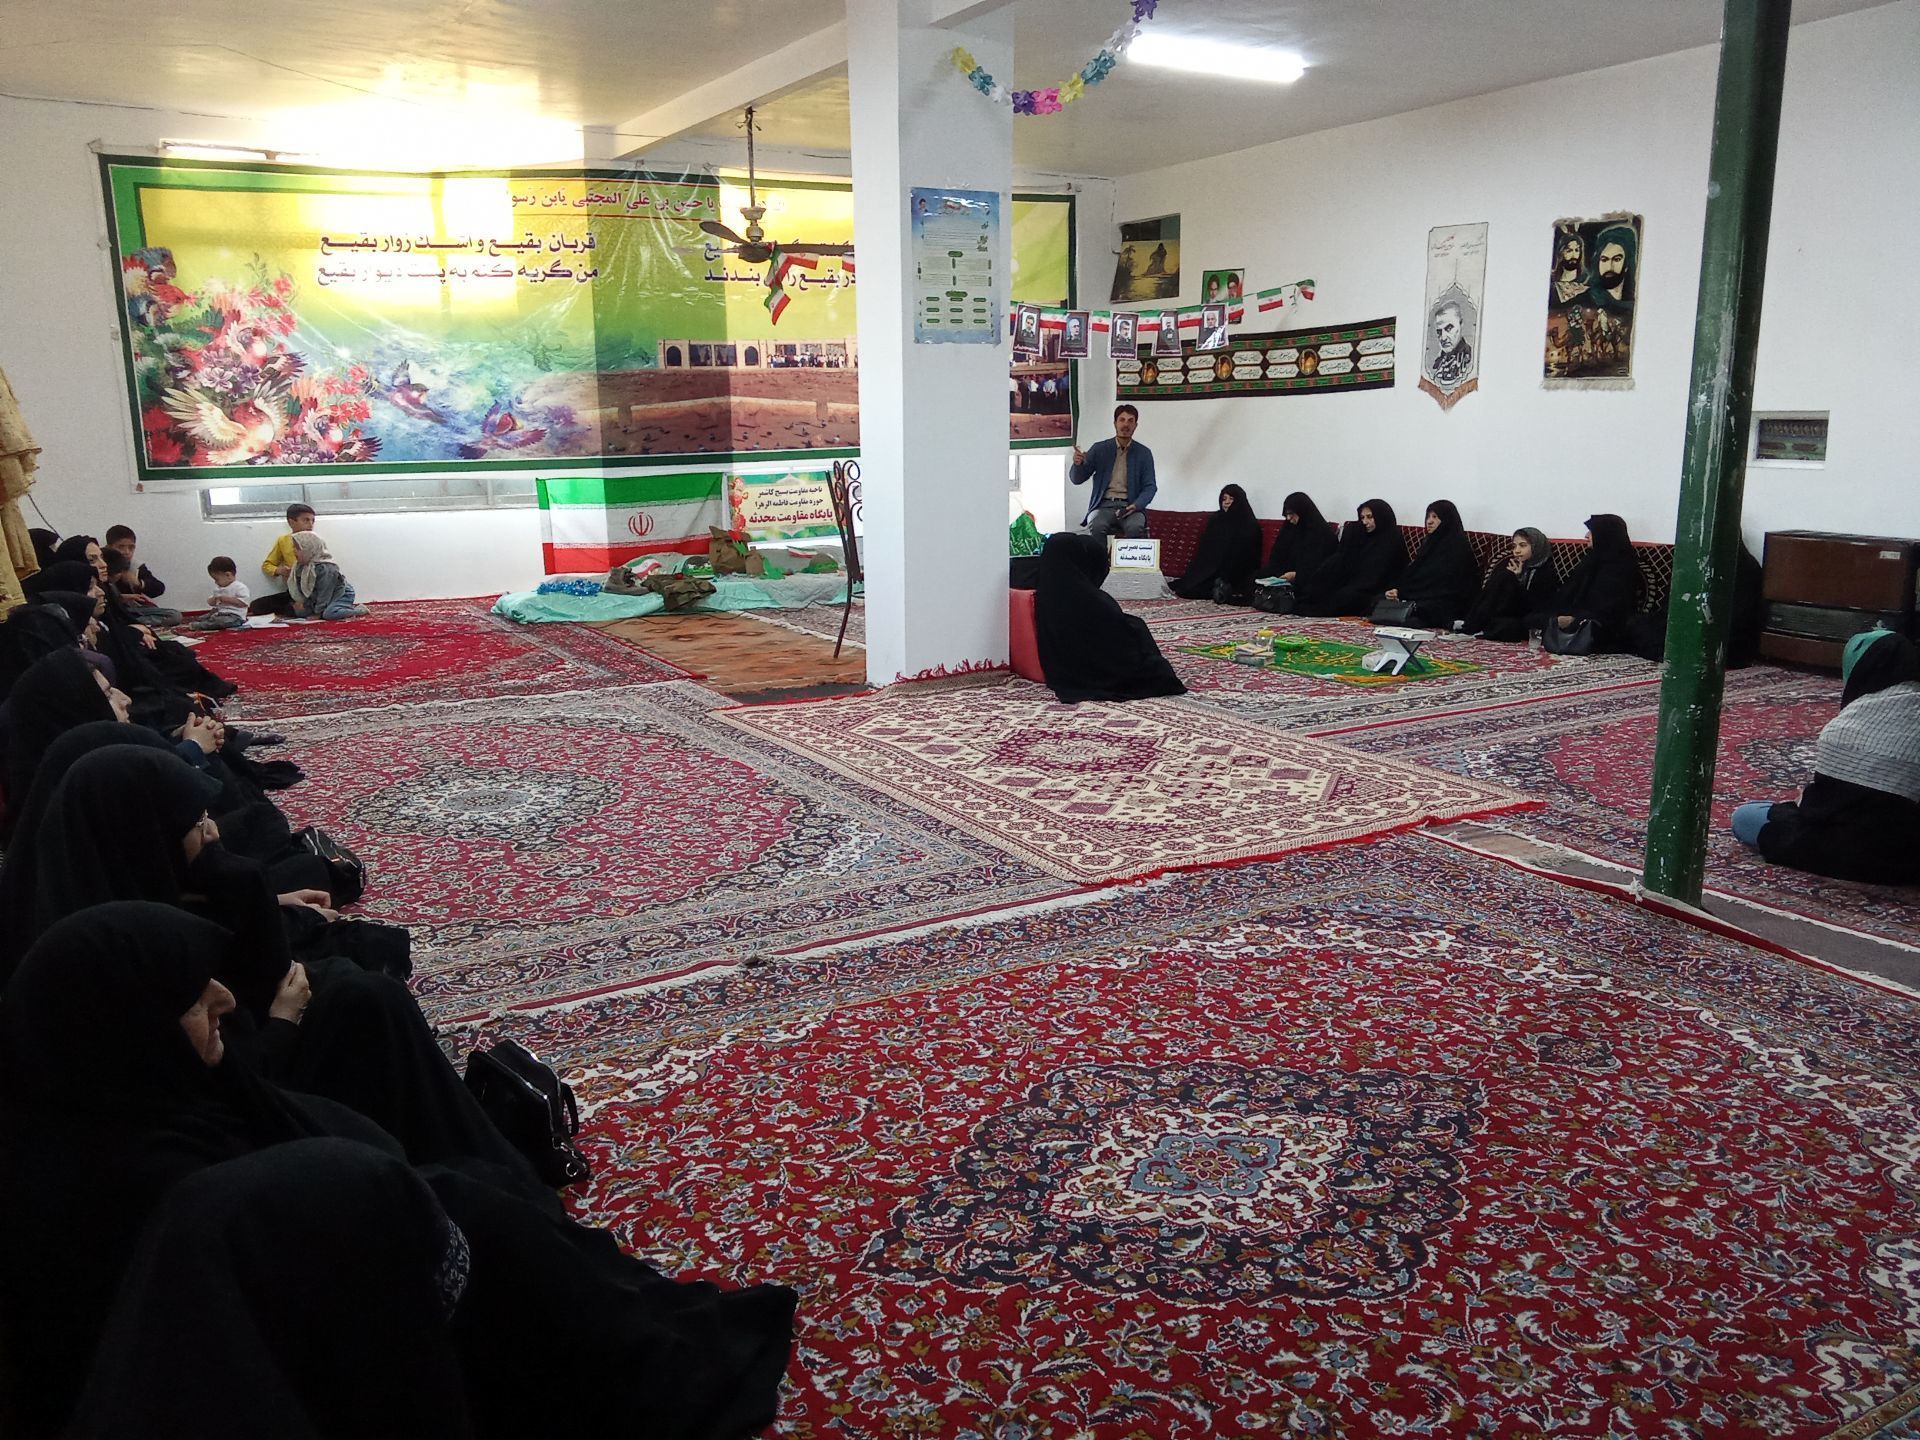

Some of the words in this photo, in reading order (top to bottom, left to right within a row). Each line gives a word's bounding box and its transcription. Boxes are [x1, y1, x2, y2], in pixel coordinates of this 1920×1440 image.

[321, 231, 378, 256] بقیع
[488, 232, 542, 257] بقیع
[549, 232, 596, 254] قربان
[517, 259, 573, 283] گریه
[576, 263, 599, 283] من
[778, 510, 808, 524] مقاومت
[810, 508, 833, 522] پایگاه
